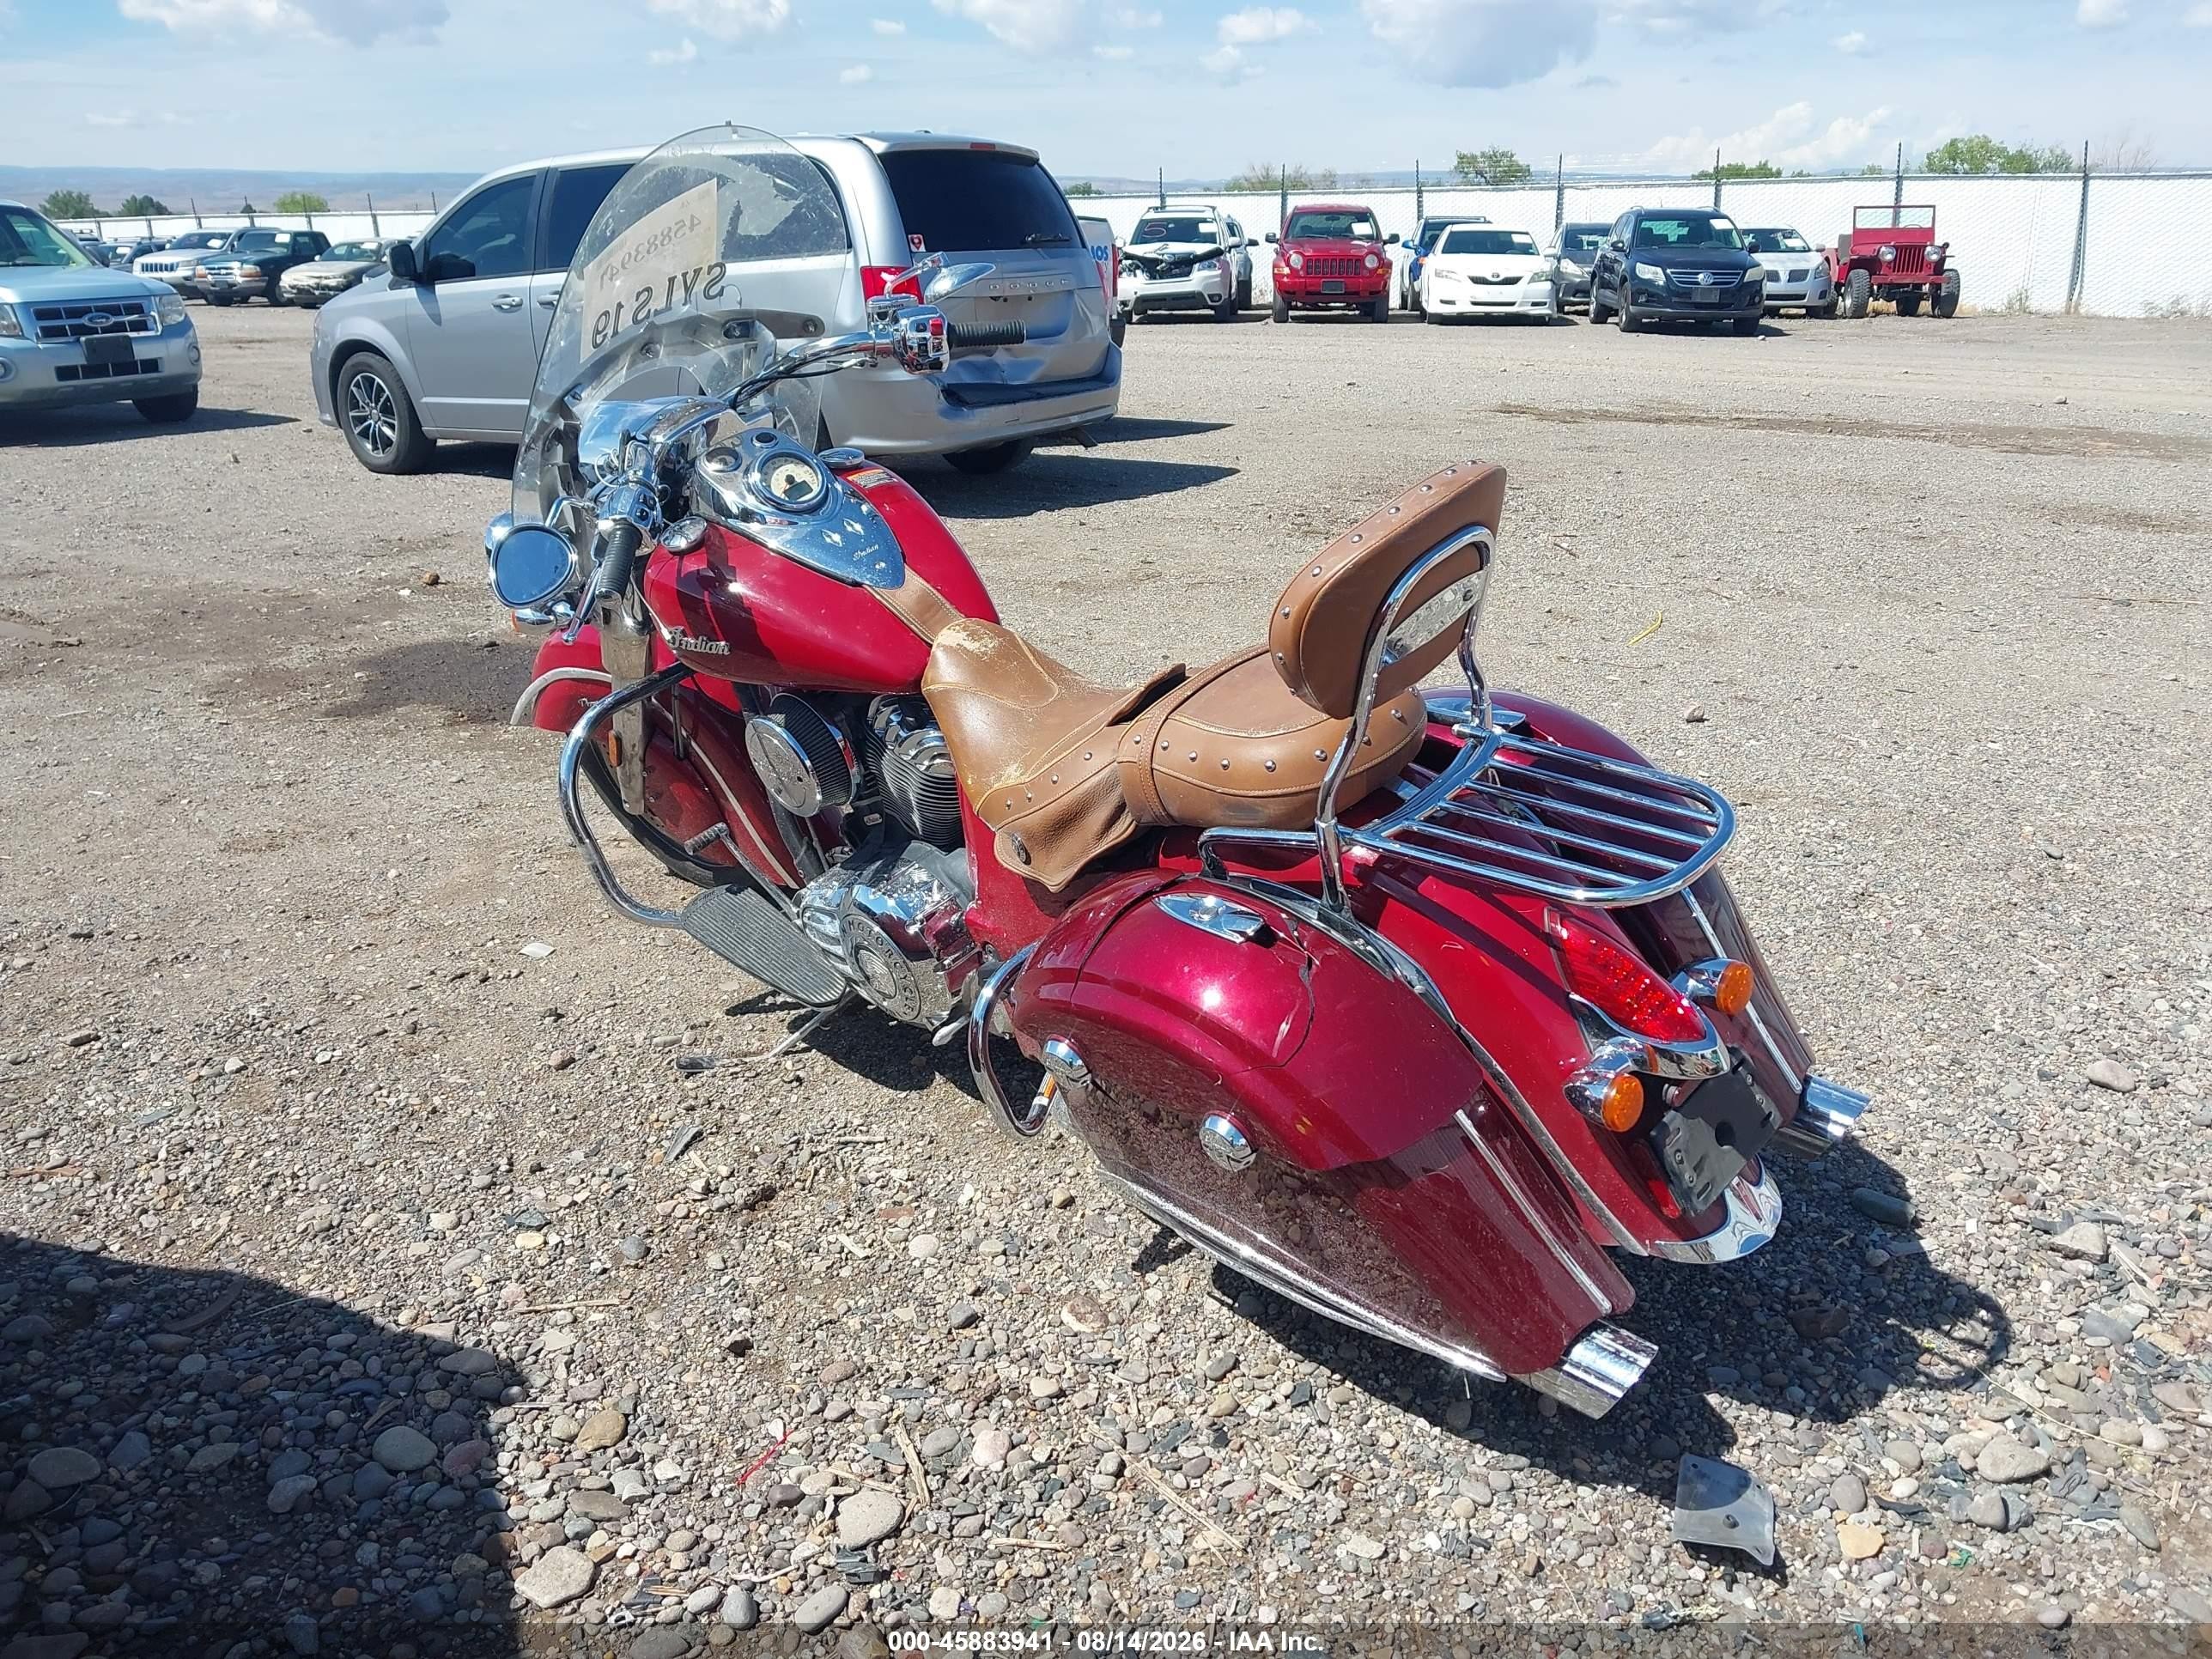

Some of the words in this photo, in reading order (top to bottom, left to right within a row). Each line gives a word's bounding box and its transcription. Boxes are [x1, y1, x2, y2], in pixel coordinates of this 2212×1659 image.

[1141, 222, 1168, 238] 5
[853, 544, 879, 562] Indian
[668, 626, 731, 655] Indian
[848, 919, 915, 1013] MOTORCYCLE
